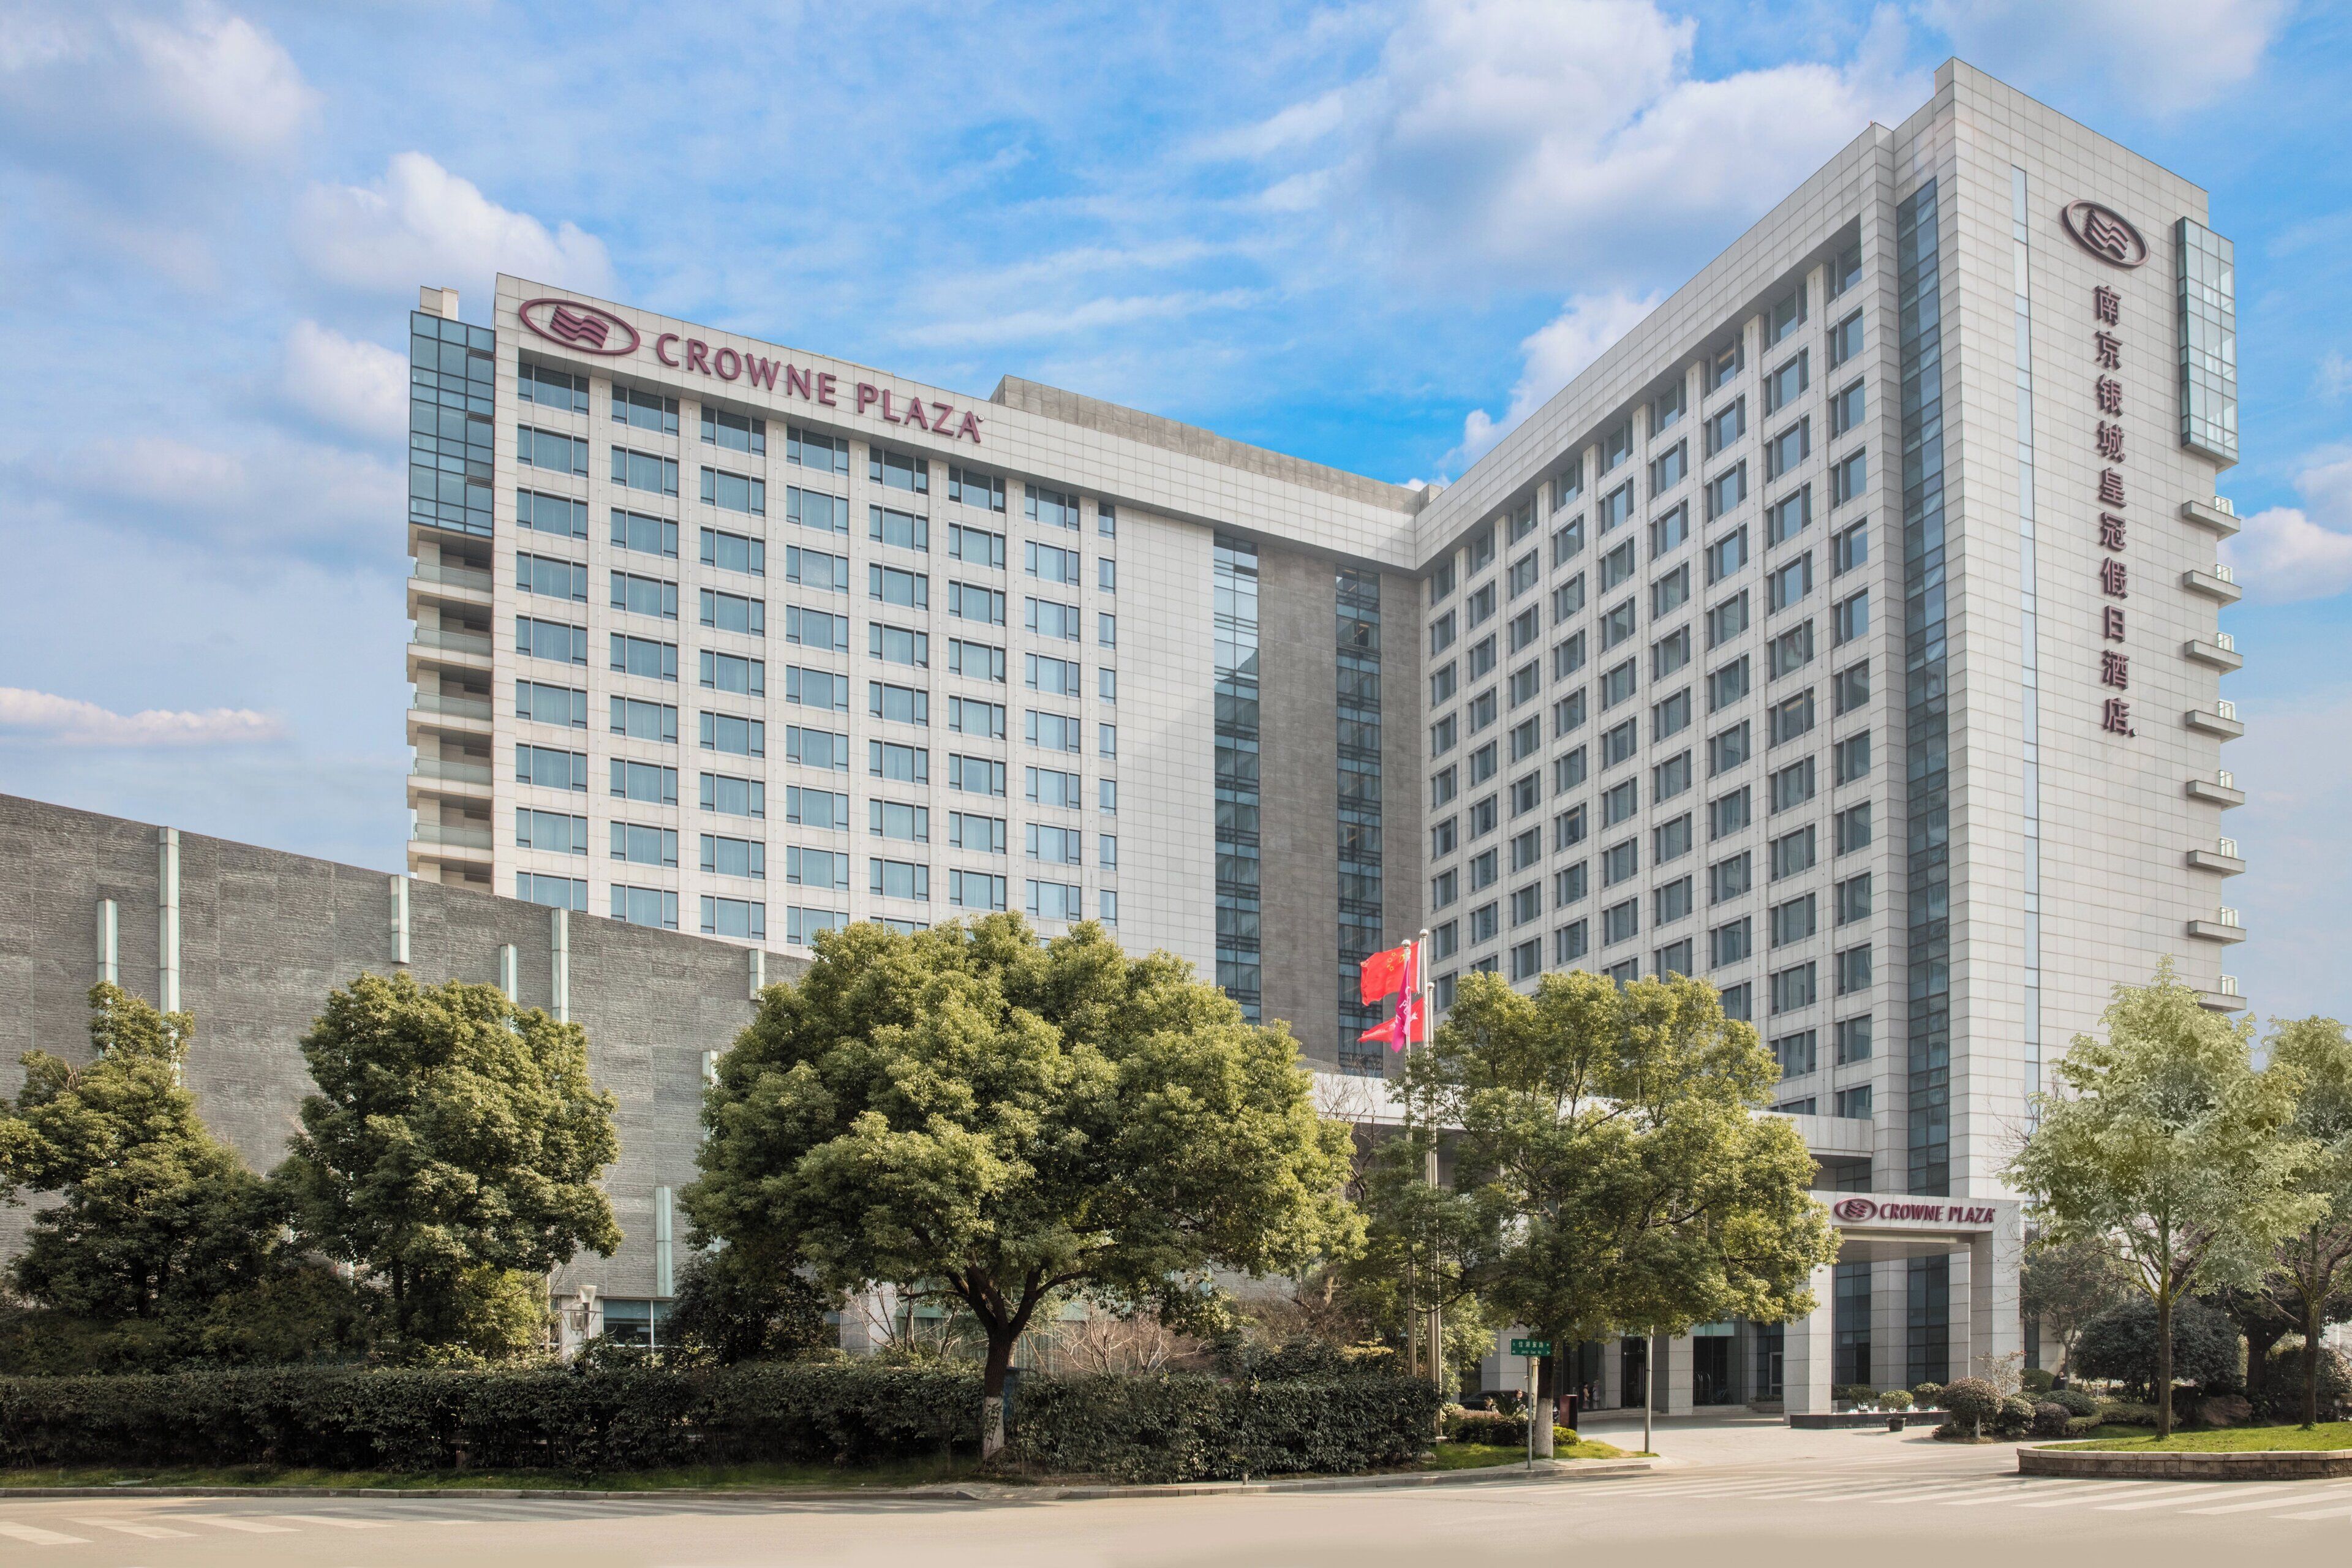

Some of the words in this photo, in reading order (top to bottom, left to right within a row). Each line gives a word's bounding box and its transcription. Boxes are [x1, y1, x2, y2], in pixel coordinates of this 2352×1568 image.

[657, 333, 836, 407] CROWNE
[858, 382, 981, 443] PLAZA
[2095, 285, 2130, 735] 南京银城皇冠假日酒店
[1880, 1203, 1945, 1221] CROWNE
[1948, 1206, 1994, 1223] PLAZA
